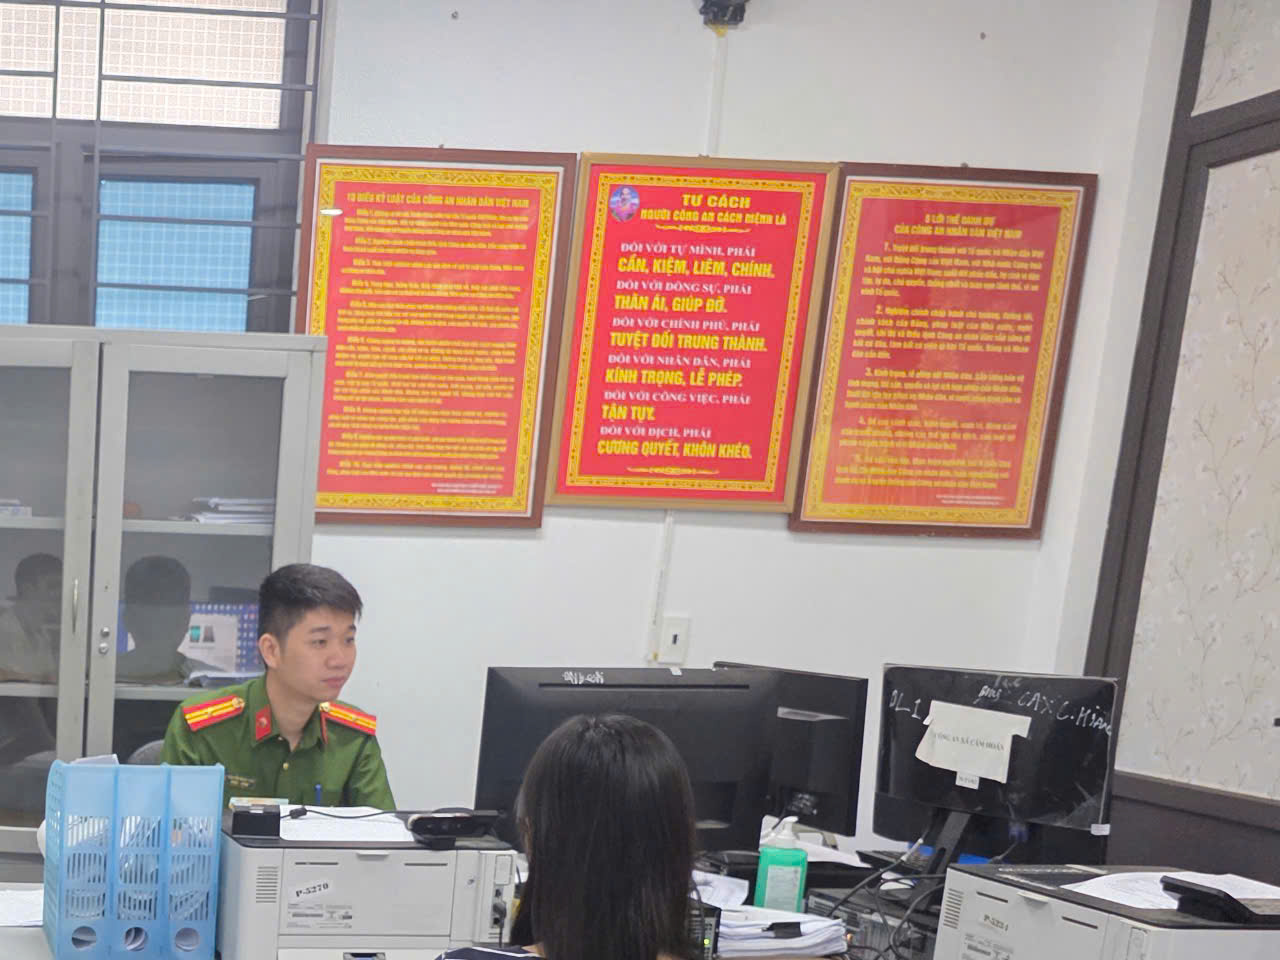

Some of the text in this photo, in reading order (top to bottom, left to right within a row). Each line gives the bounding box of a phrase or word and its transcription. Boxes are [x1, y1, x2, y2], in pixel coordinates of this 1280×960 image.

[682, 194, 751, 208] TƯ CÁCH
[673, 209, 699, 221] CÔNG
[702, 211, 714, 222] AN
[717, 211, 742, 223] CÁCH
[621, 242, 642, 252] ĐỐI
[646, 242, 666, 253] VỚI
[671, 244, 688, 255] TỰ
[653, 256, 689, 276] KIỆM,
[693, 258, 728, 276] LIÊM,
[732, 259, 775, 278] CHÍNH.
[617, 279, 638, 290] ĐỐI
[642, 279, 662, 291] VỚI
[615, 292, 648, 310] THÂN
[672, 295, 703, 312] GIÚP
[706, 295, 728, 313] ĐỠ.
[613, 316, 634, 327] ĐỐI
[638, 317, 658, 328] VỚI
[661, 317, 700, 329] CHÍNH
[610, 330, 768, 352] TUYỆT ĐỐI TRUNG THÀNH.
[608, 353, 630, 364] ĐỐI
[633, 353, 654, 365] VỚI
[605, 366, 743, 387] KÍNH TRỌNG, LỄ PHÉP.
[604, 389, 626, 400] ĐỐI
[629, 390, 650, 401] VỚI
[602, 403, 628, 422] TẬN
[600, 425, 622, 435] ĐỐI
[625, 425, 645, 436] VỚI
[683, 440, 716, 457] KHÔN
